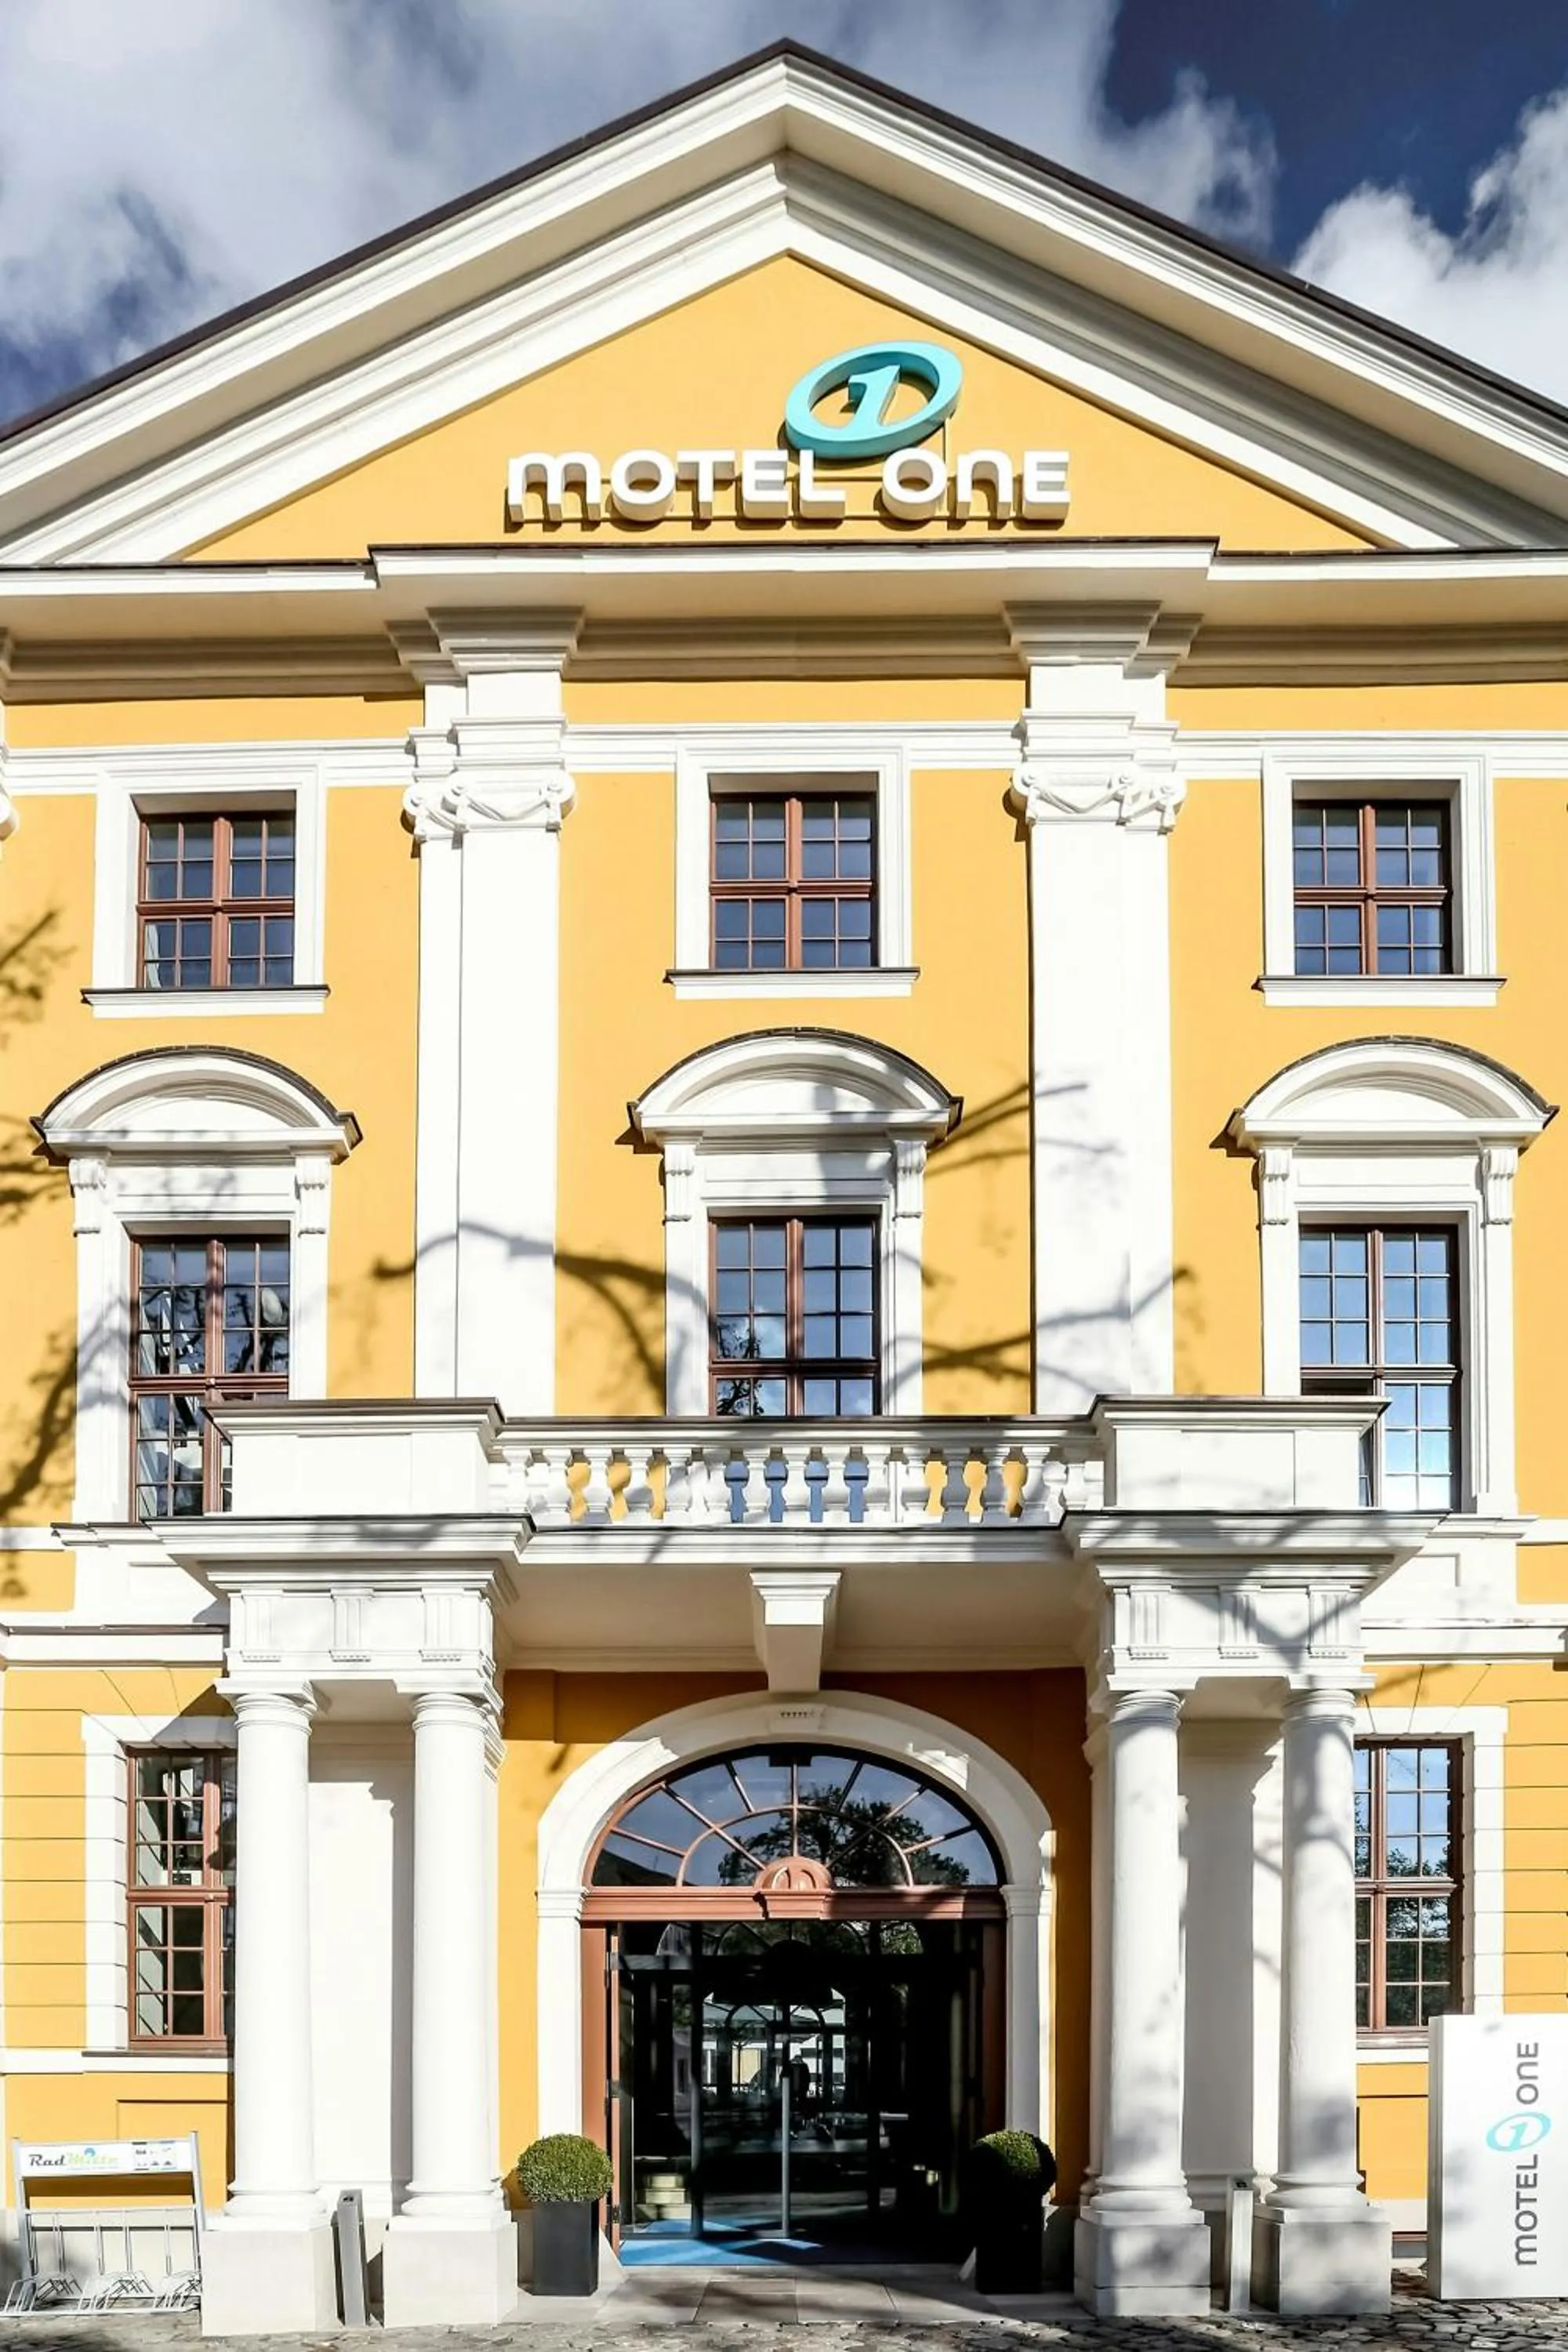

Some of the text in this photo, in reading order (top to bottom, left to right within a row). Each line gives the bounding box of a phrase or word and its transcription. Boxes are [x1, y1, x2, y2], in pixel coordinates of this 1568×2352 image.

[507, 447, 1070, 521] MOTEL ONE
[1515, 2042, 1539, 2265] MOTEL ONE
